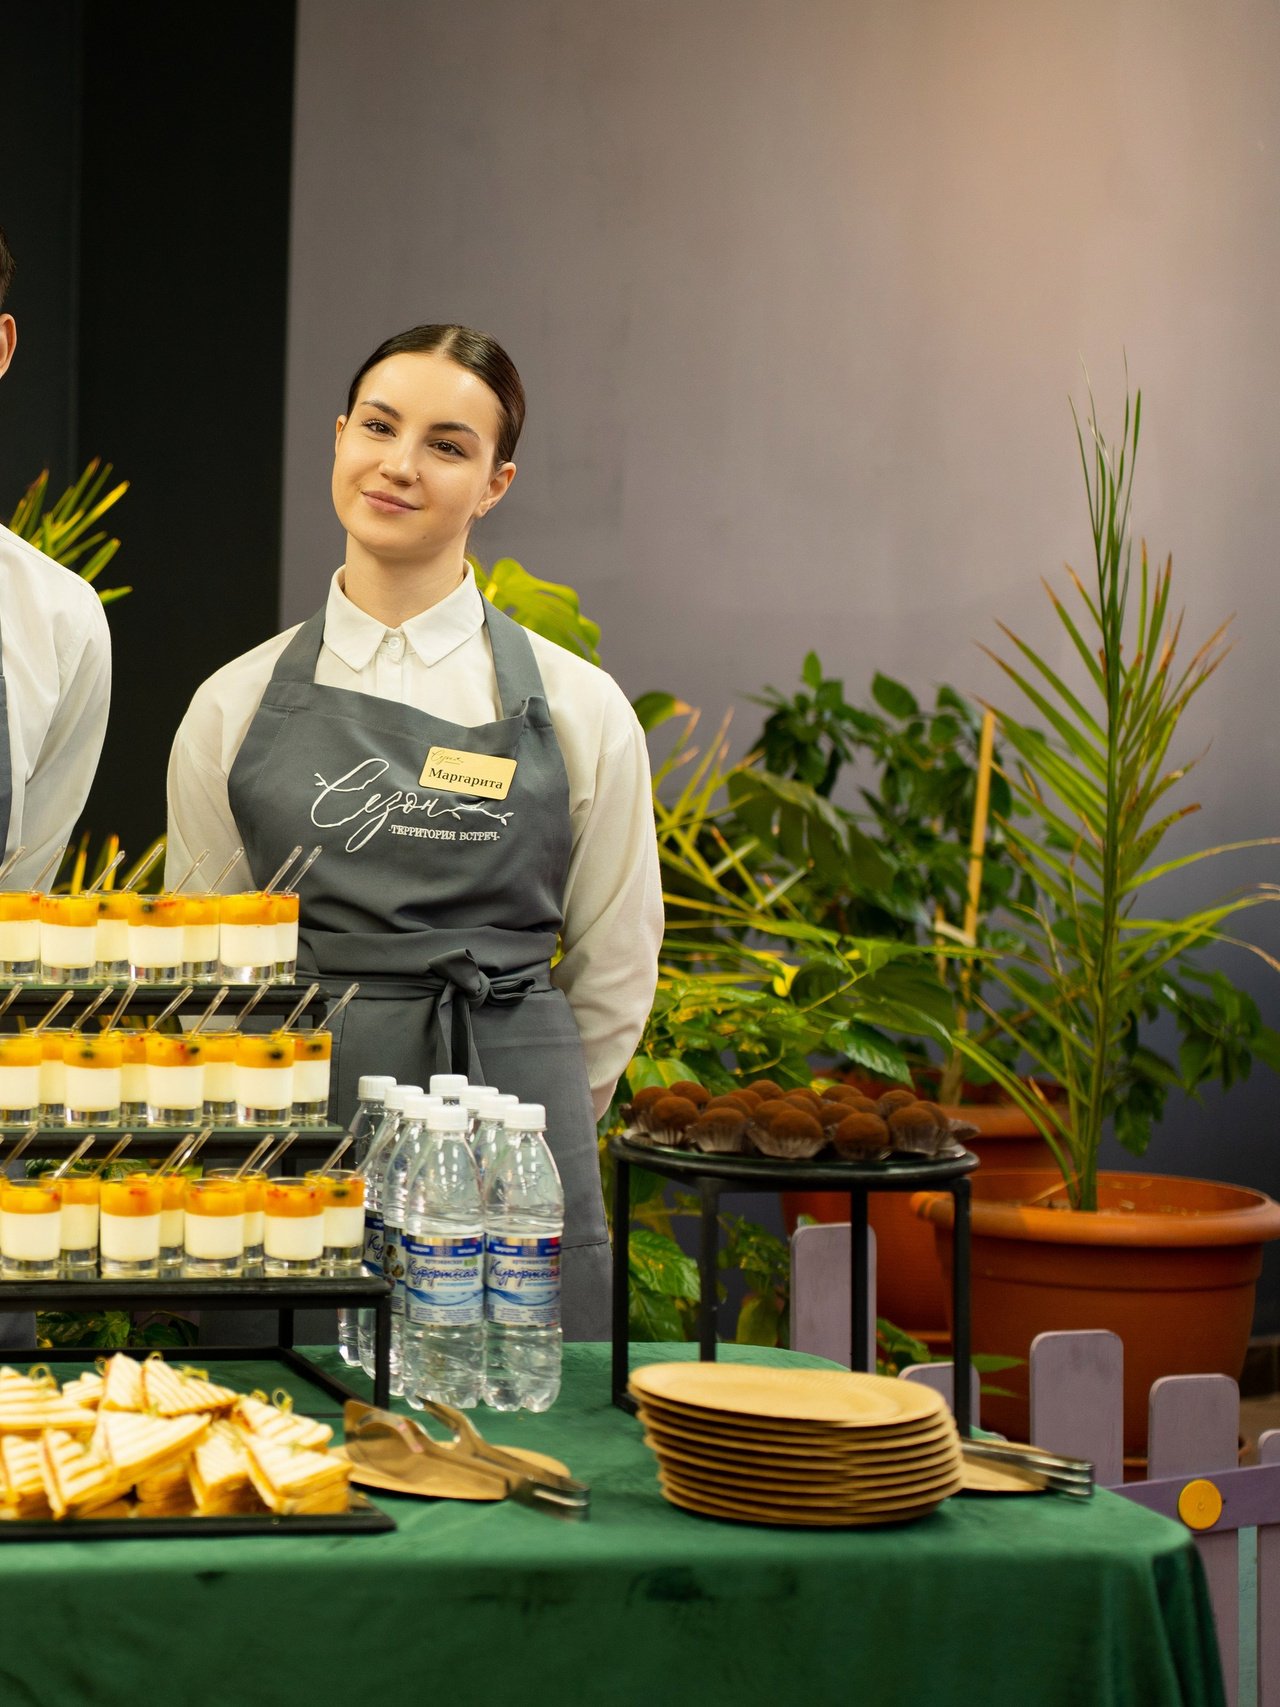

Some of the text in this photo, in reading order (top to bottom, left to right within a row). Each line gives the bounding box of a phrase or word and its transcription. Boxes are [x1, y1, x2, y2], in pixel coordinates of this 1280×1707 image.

[428, 767, 503, 790] Маргарита
[310, 757, 440, 853] Сезон
[407, 1257, 479, 1288] Курортная
